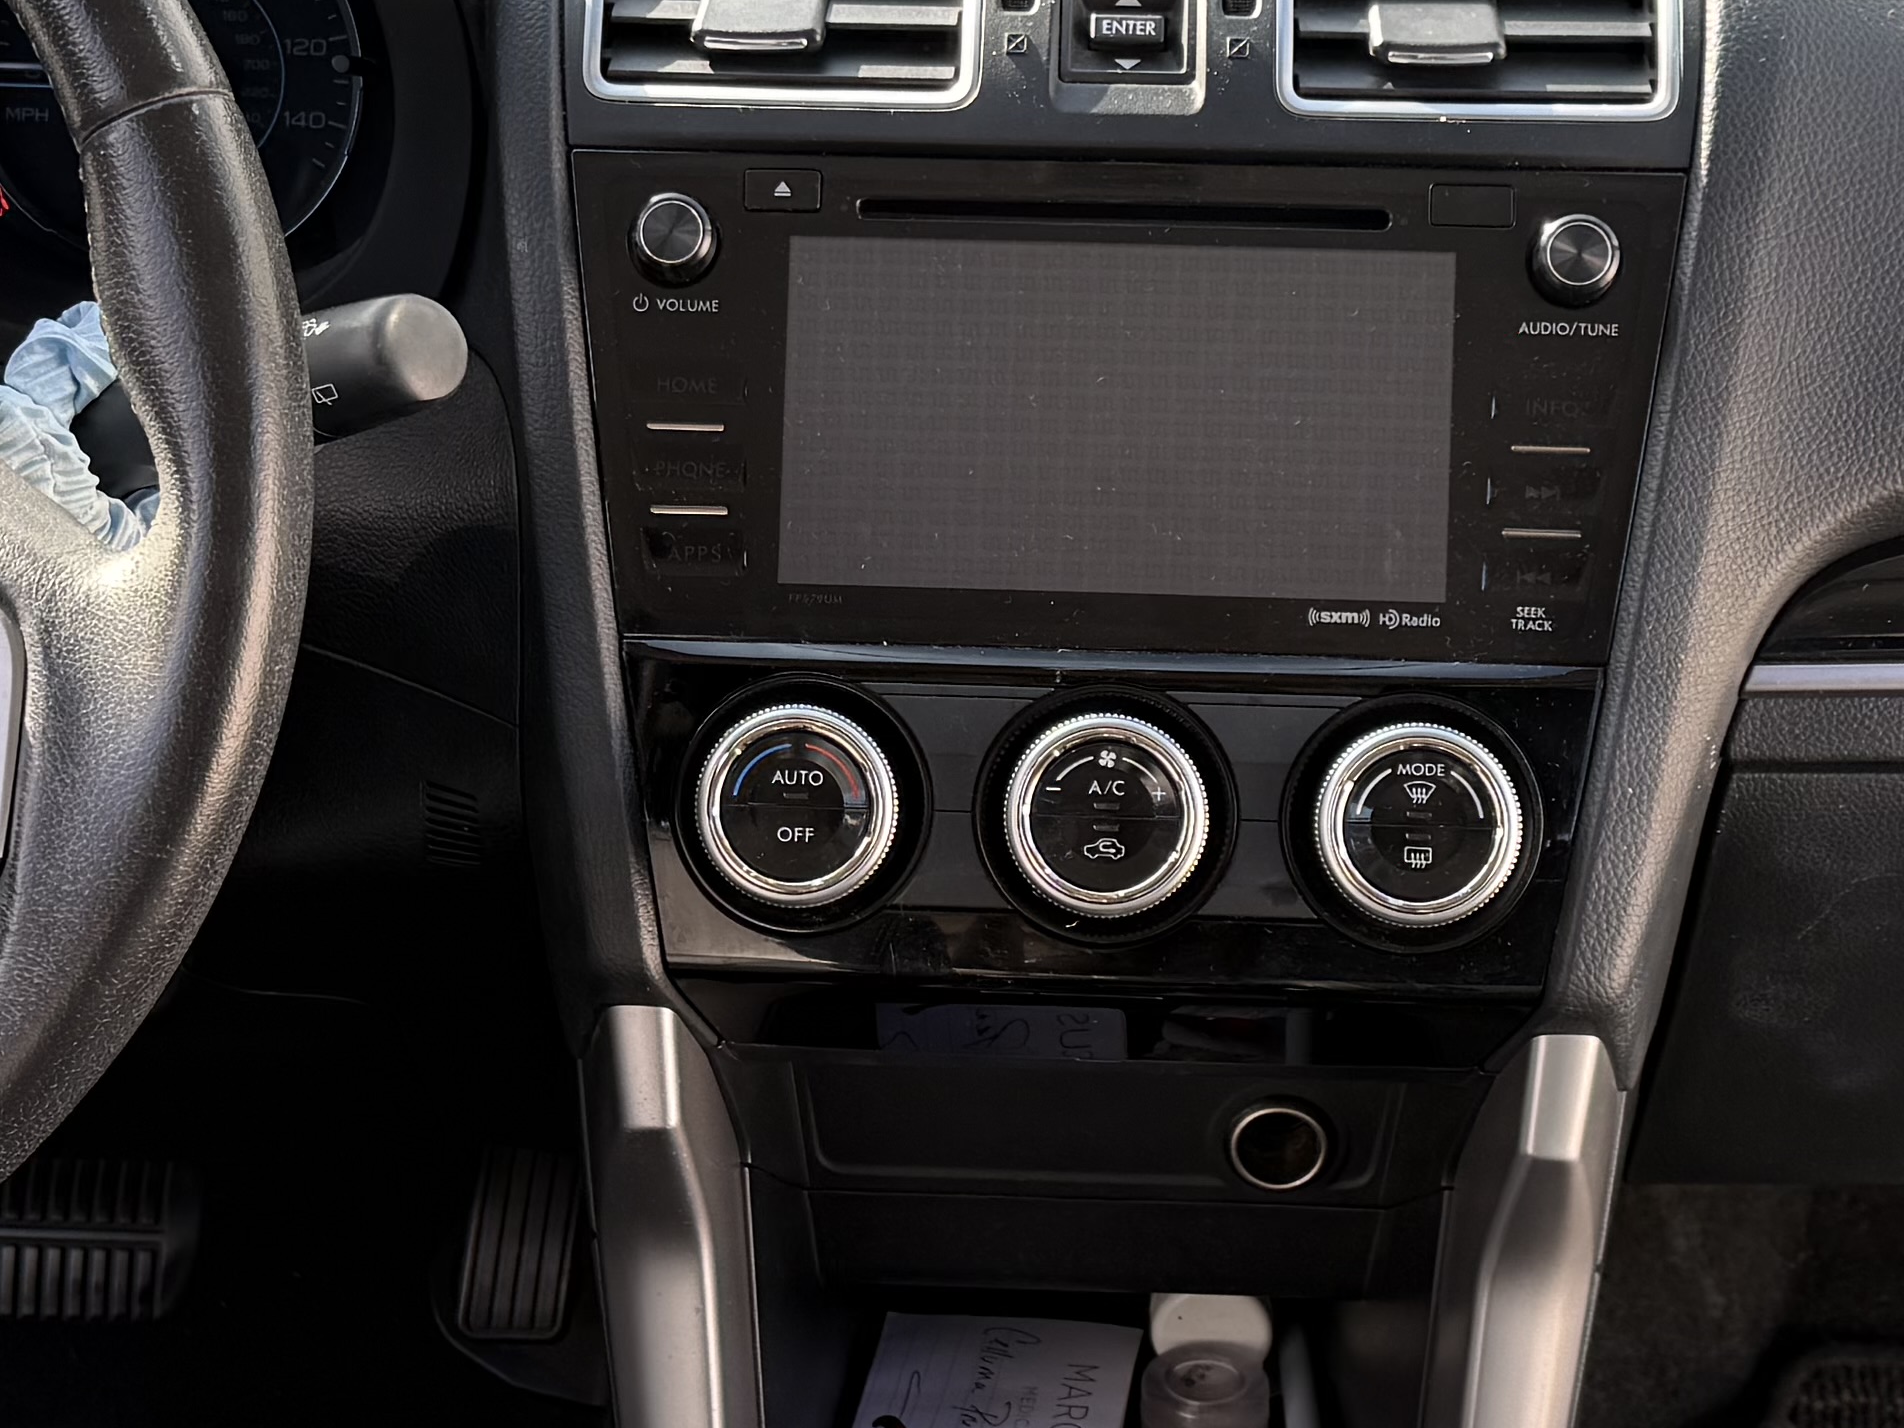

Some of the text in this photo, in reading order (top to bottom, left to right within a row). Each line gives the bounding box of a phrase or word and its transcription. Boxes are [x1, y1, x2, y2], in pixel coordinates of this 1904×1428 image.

[1101, 19, 1157, 36] ENTER
[285, 38, 329, 56] 120
[5, 107, 50, 122] MPH
[284, 110, 327, 129] 140
[655, 297, 720, 313] VOLUME
[1517, 321, 1620, 338] AUDIO/TUNE
[656, 376, 718, 394] HOME
[1525, 398, 1580, 415] INFO
[655, 460, 727, 478] PHONE
[668, 546, 722, 562] APPS
[1401, 612, 1442, 628] Radio
[1515, 605, 1547, 619] SEEK
[1510, 618, 1553, 633] TRACK
[1396, 762, 1446, 777] MODE
[771, 770, 825, 787] AUTO
[1088, 779, 1126, 797] A/C
[776, 826, 816, 843] OFF
